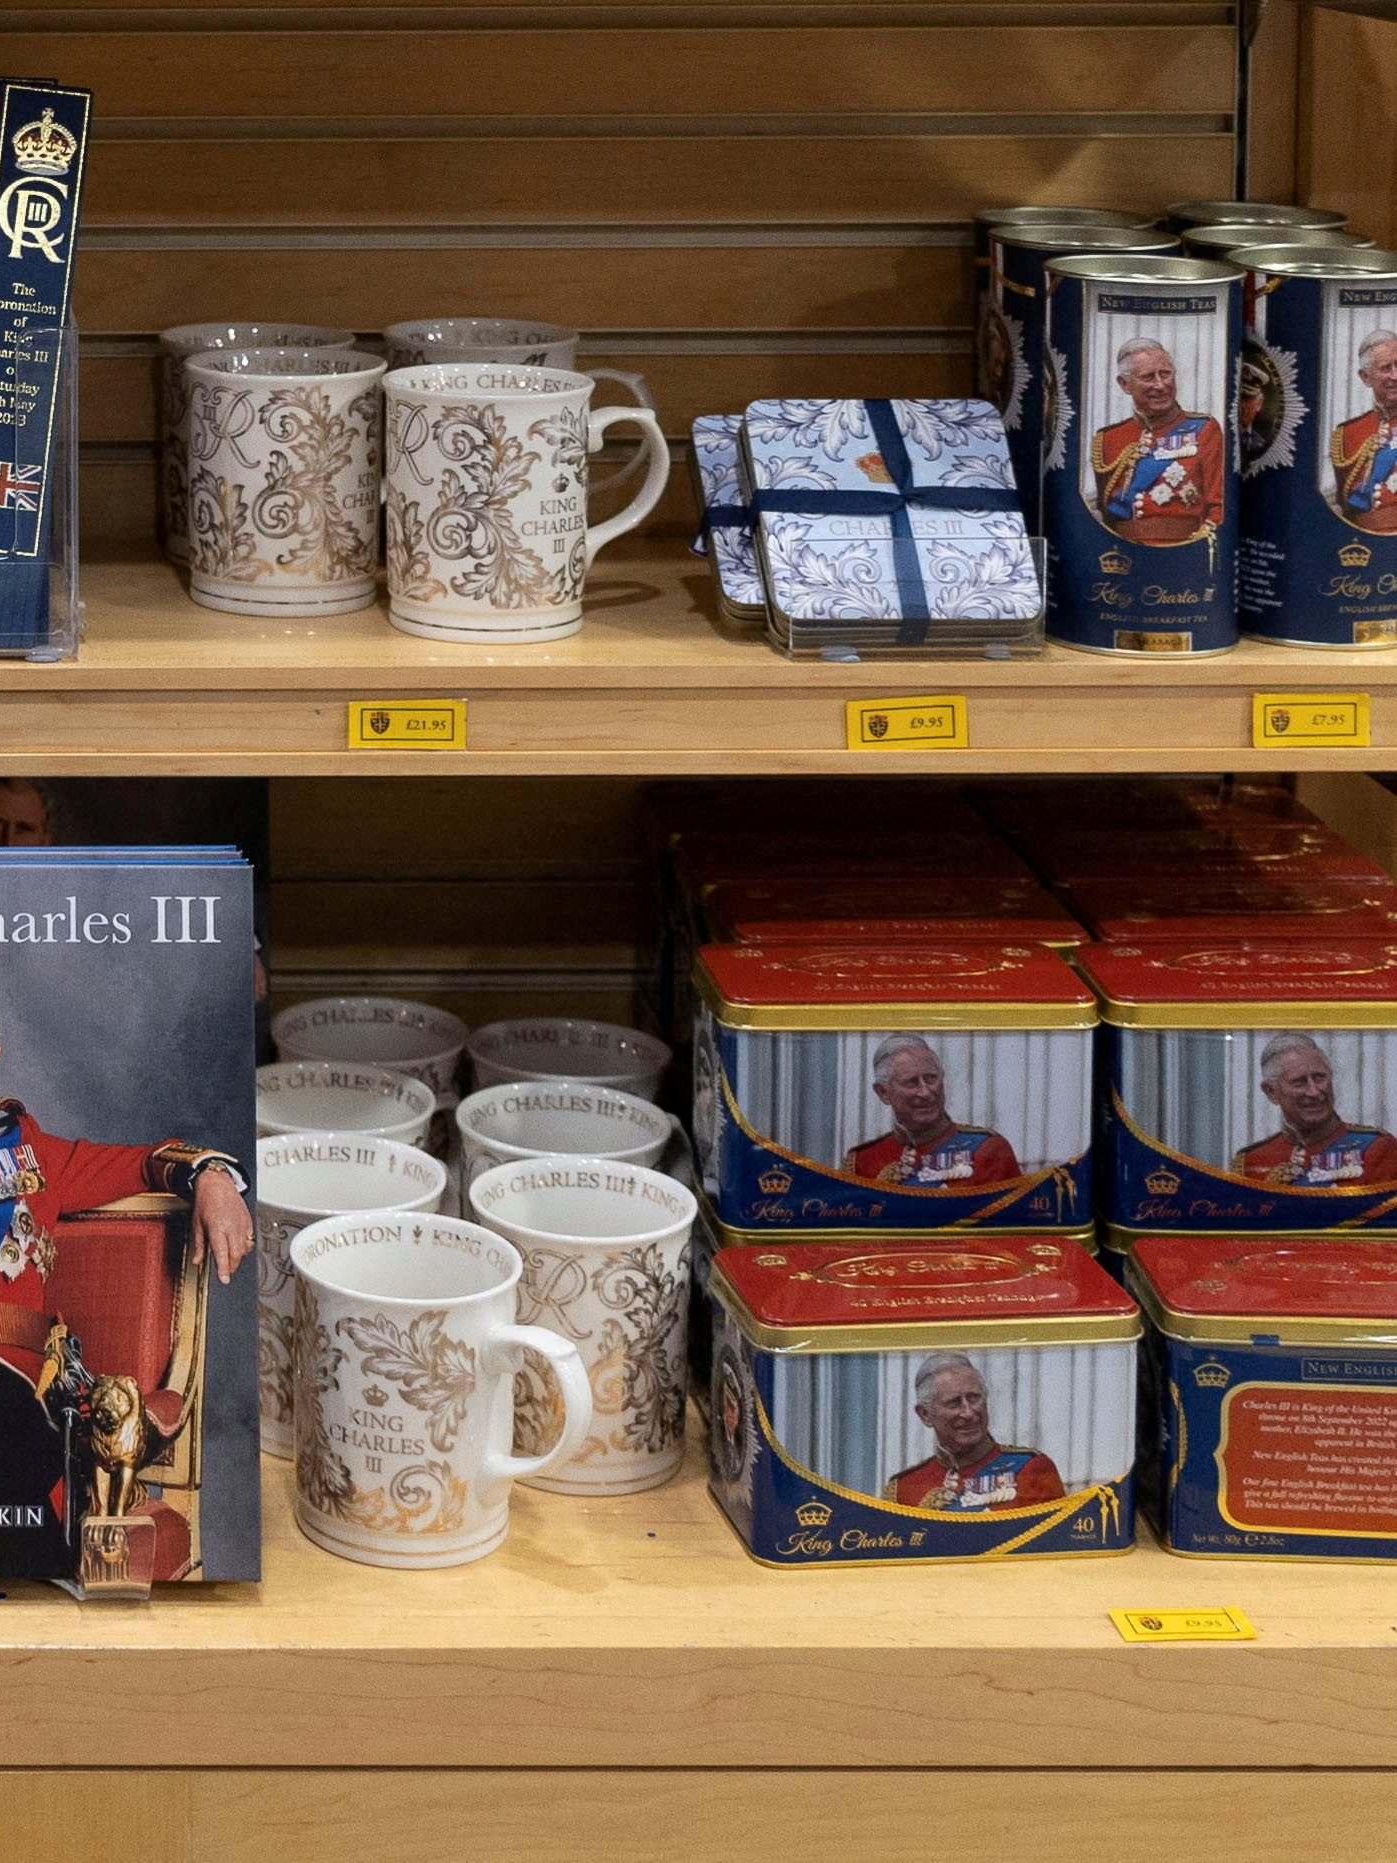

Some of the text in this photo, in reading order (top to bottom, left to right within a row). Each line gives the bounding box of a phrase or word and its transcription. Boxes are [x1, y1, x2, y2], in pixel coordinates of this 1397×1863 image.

[12, 283, 36, 296] The
[1342, 291, 1370, 302] NEW
[1190, 298, 1216, 310] TEAS
[13, 316, 28, 328] of
[34, 350, 50, 363] III
[539, 497, 578, 516] KING
[520, 515, 585, 538] CHARLES
[944, 519, 964, 535] III
[552, 538, 566, 556] III
[1089, 582, 1133, 608] King
[1141, 585, 1200, 606] Charles
[1318, 573, 1373, 600] King
[405, 719, 447, 731] £21.95
[909, 716, 943, 729] £9.95
[1311, 714, 1346, 726] £7.95
[150, 896, 222, 945] III
[503, 1094, 593, 1113] CHARLES
[263, 1147, 375, 1168] CHARLES III
[509, 1171, 600, 1192] CHARLES
[606, 1175, 627, 1191] III
[751, 1200, 794, 1223] King
[802, 1199, 862, 1217] Charles
[1029, 1197, 1050, 1211] 40
[1133, 1200, 1182, 1221] King
[1189, 1200, 1252, 1217] Charles
[432, 1229, 482, 1257] KING
[1307, 1361, 1339, 1375] NEW
[350, 1409, 404, 1432] KING
[328, 1424, 426, 1456] CHARLES
[364, 1455, 382, 1475] III
[1073, 1516, 1096, 1533] 40
[777, 1528, 928, 1556] King Charles III
